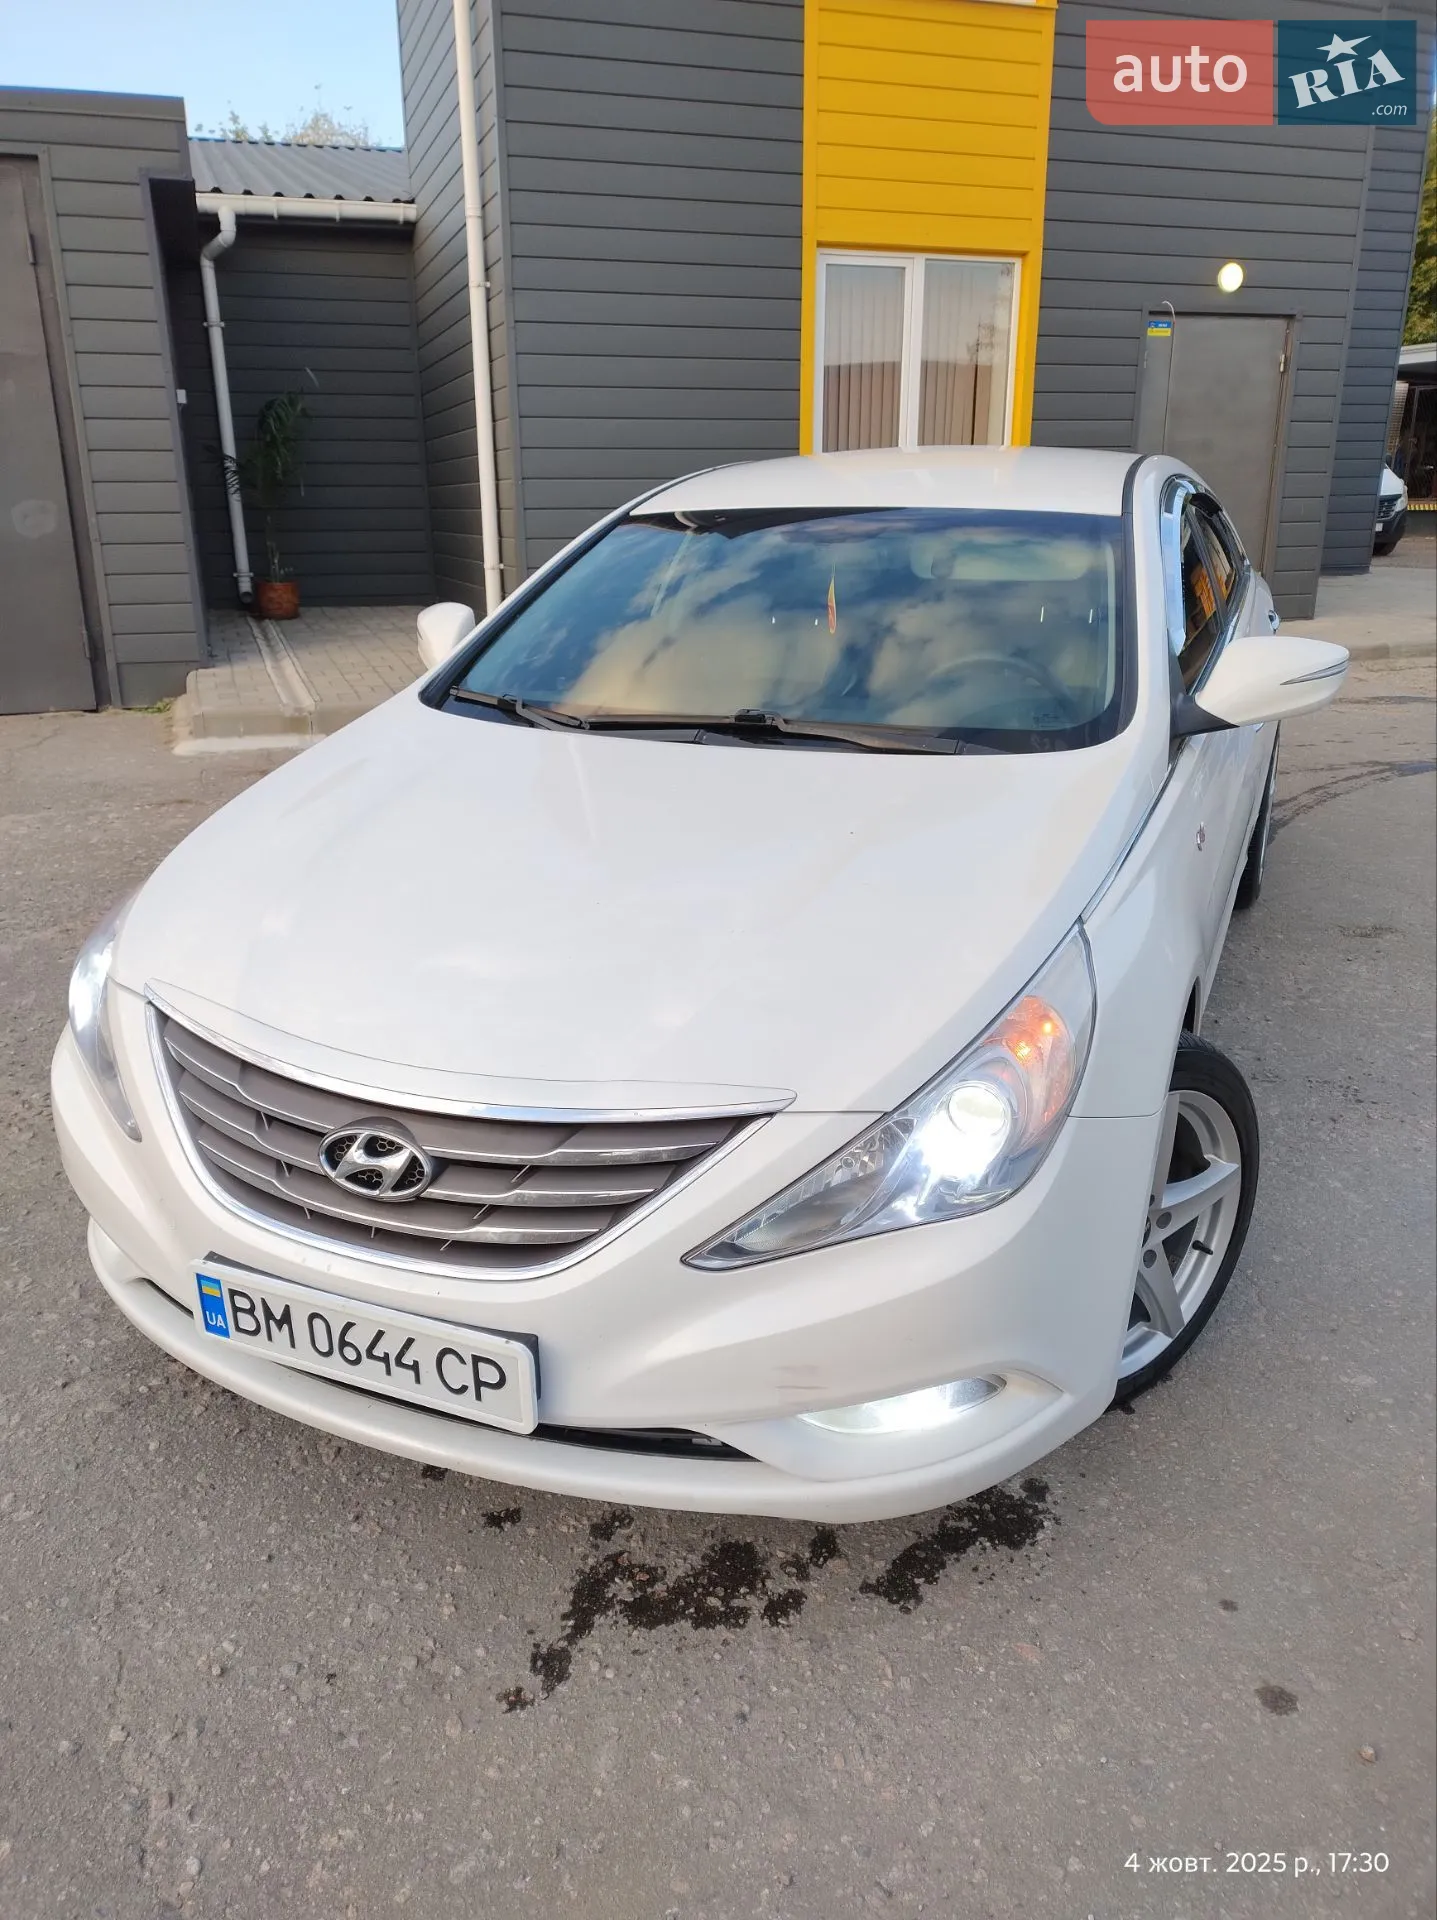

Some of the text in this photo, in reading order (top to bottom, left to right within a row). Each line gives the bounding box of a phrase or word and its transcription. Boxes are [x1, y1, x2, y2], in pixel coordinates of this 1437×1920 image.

[205, 1310, 227, 1329] UA
[227, 1287, 507, 1402] BM 0644 CP
